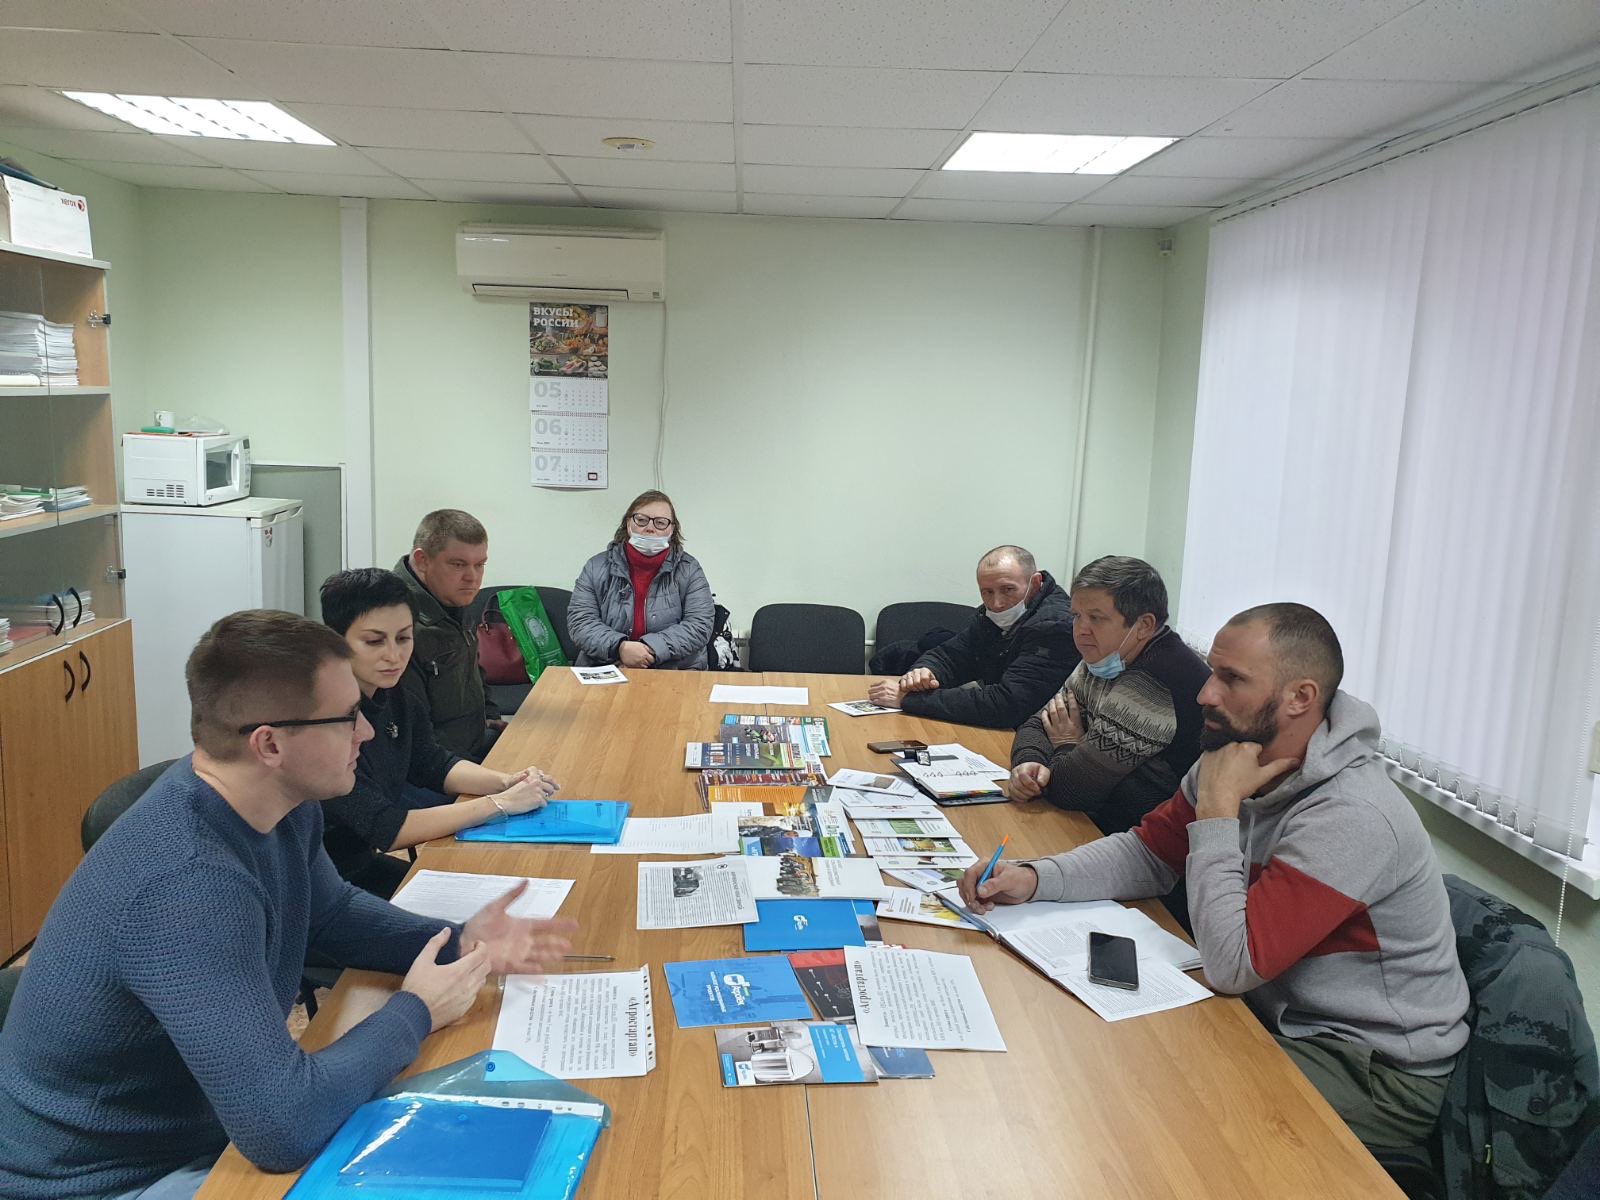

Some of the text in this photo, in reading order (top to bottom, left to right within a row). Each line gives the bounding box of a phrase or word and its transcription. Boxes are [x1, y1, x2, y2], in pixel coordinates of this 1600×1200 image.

[533, 306, 574, 317] ВКУСЫ
[533, 318, 580, 328] РОССИИ
[534, 380, 562, 399] 05
[534, 418, 562, 436] 06
[534, 455, 562, 472] 07
[625, 997, 641, 1057] «Агростартап»
